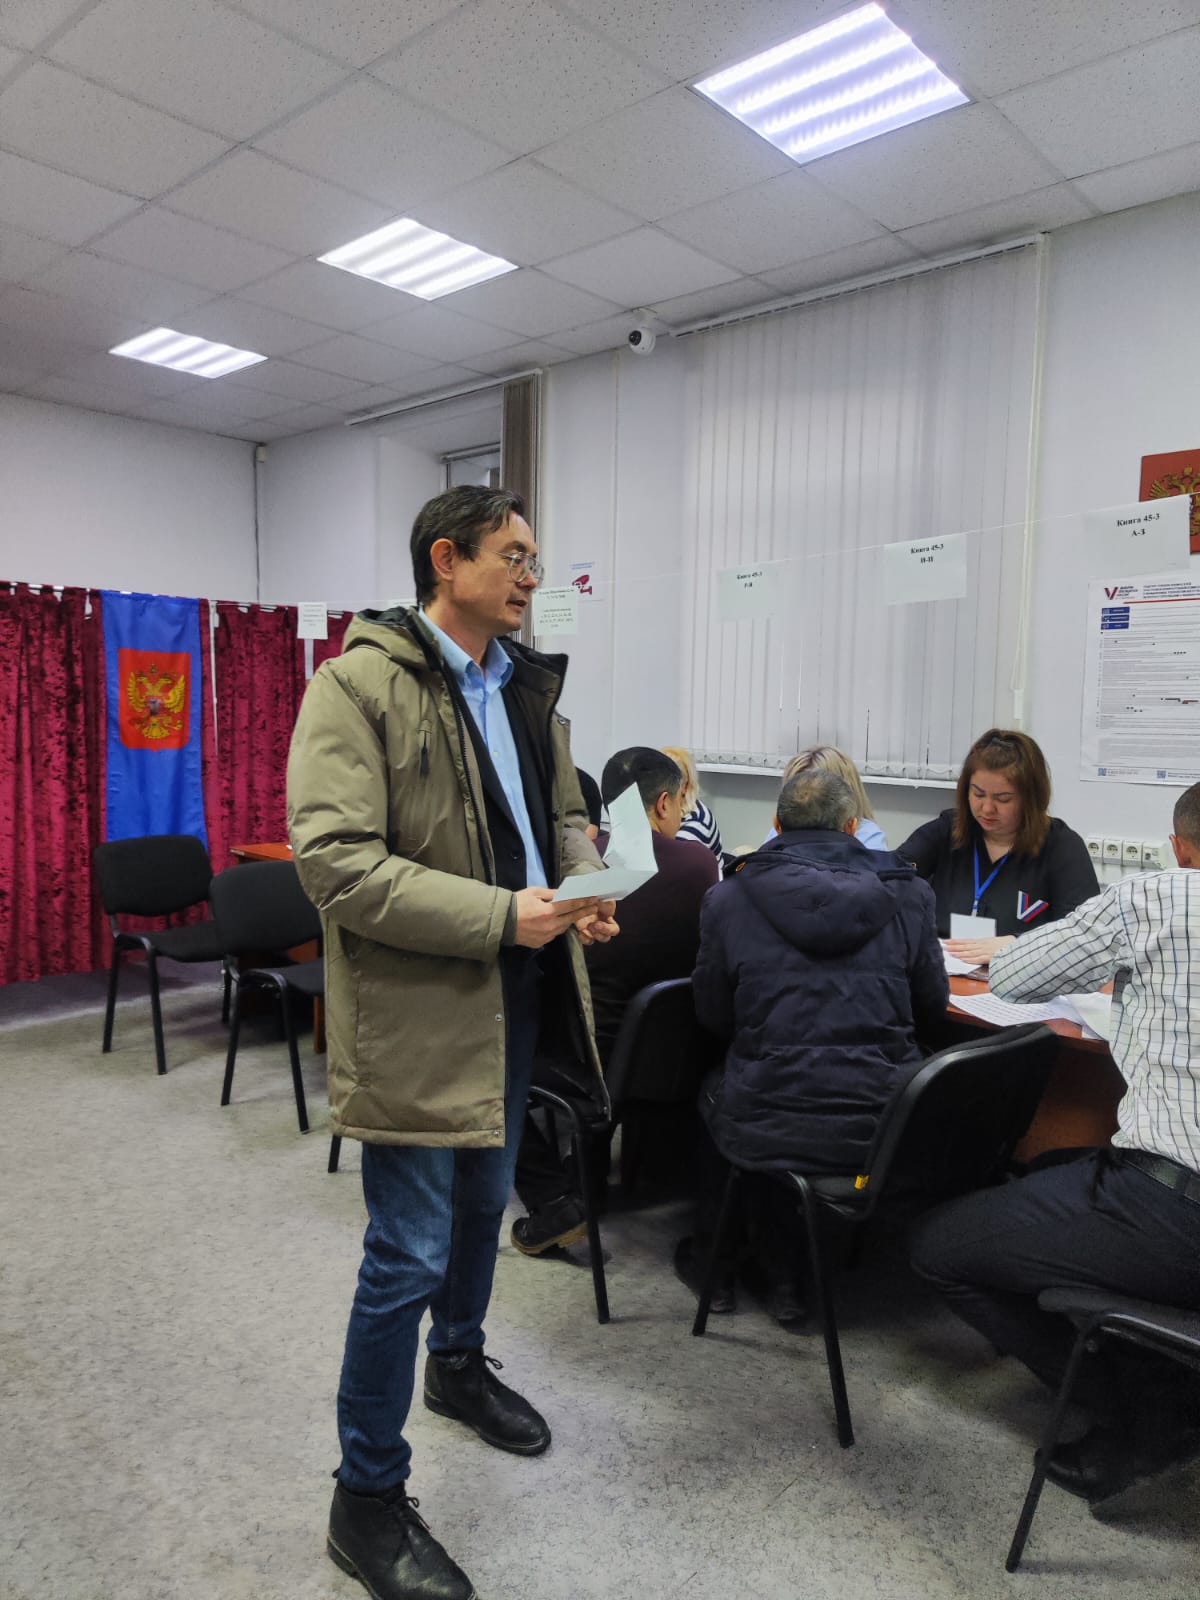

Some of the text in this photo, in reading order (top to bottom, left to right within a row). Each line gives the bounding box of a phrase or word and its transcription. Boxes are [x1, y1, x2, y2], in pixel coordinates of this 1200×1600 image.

[1117, 512, 1160, 526] Книга 45-3
[911, 543, 944, 554] Книга 45-3
